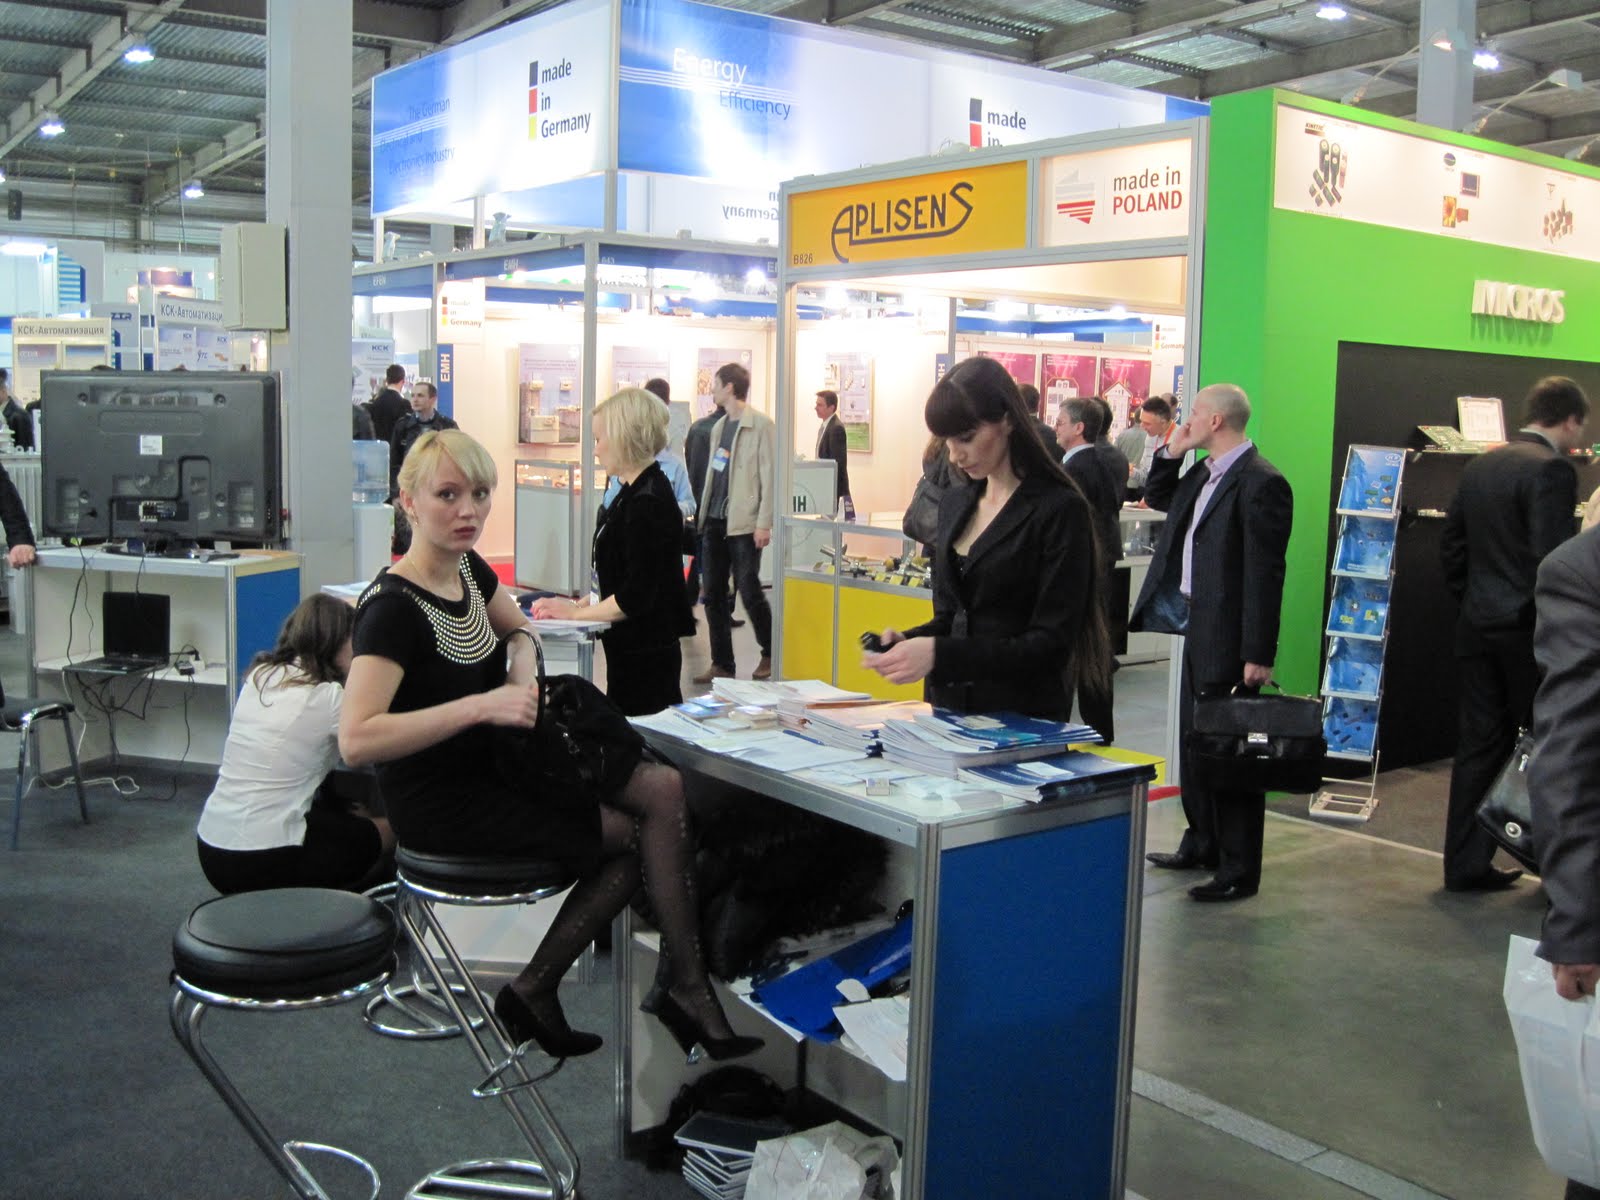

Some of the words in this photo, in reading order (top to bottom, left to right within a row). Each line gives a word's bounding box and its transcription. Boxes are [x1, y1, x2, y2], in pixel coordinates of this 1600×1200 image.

[541, 57, 572, 84] made
[673, 47, 747, 88] Energy
[541, 91, 551, 112] in
[720, 90, 791, 121] Efficiency
[541, 112, 591, 138] Germany
[987, 111, 1027, 130] made
[1113, 168, 1160, 192] made
[1165, 165, 1181, 186] in
[1113, 190, 1182, 215] POLAND
[831, 182, 974, 264] APLISENS
[793, 253, 814, 265] B826
[160, 303, 223, 325] КСК-Автоматизаци
[1471, 279, 1565, 324] MICROS
[17, 325, 105, 337] КСК-Автоматизация
[440, 353, 451, 382] EMH
